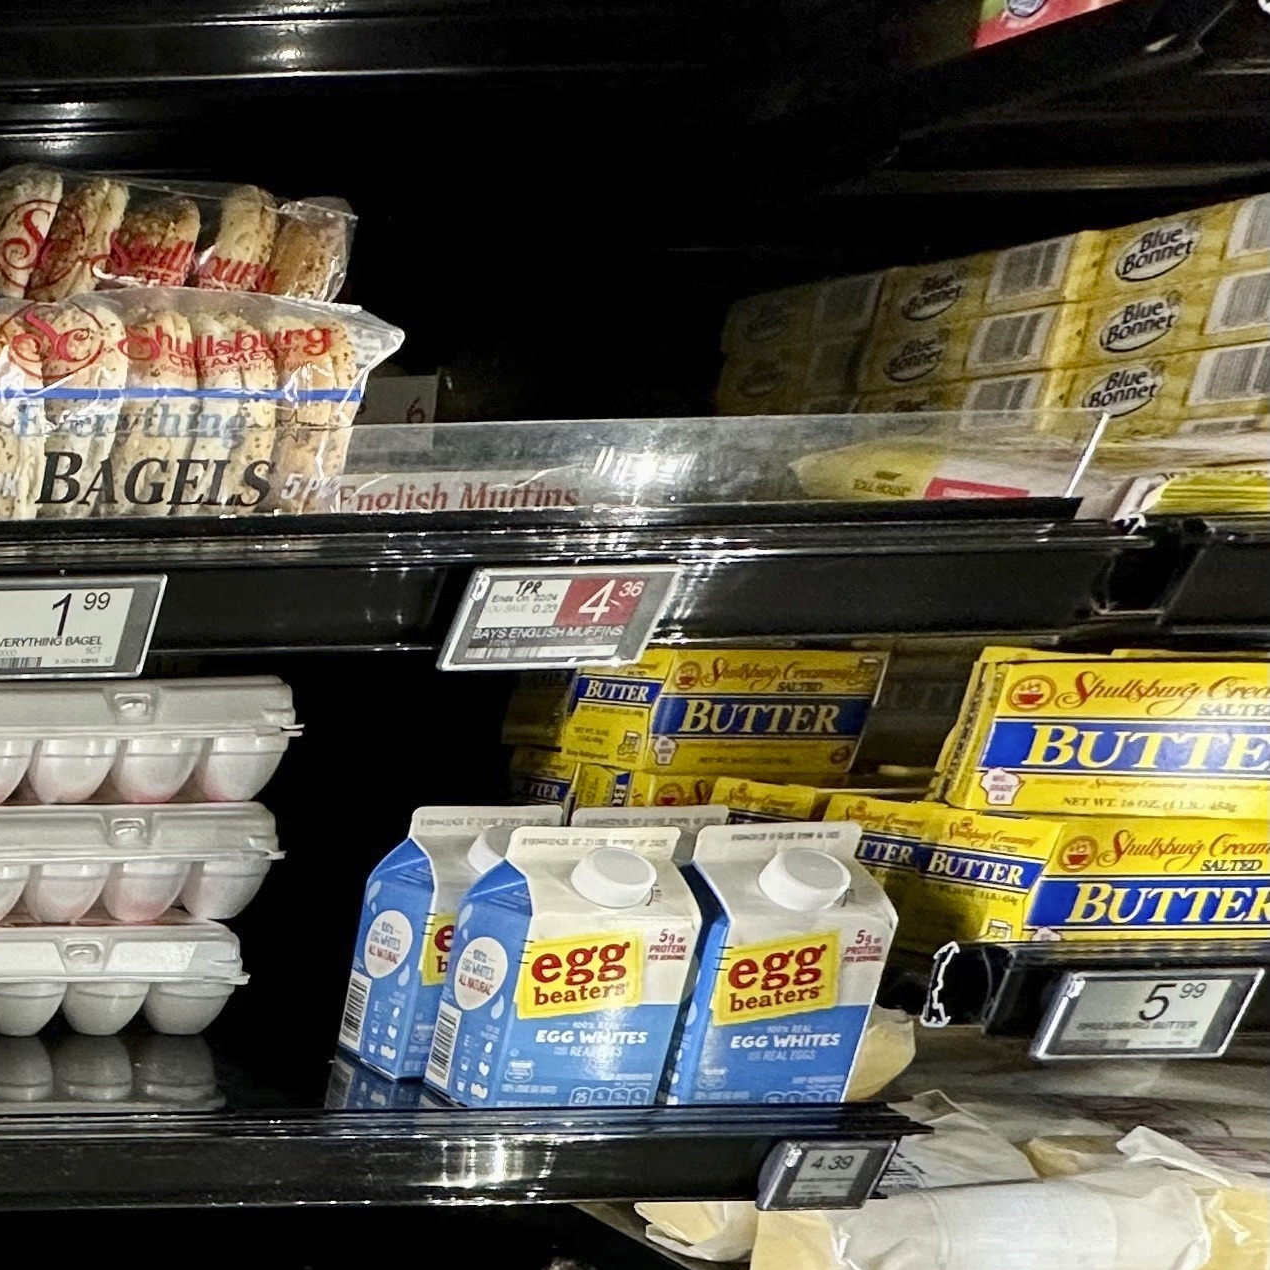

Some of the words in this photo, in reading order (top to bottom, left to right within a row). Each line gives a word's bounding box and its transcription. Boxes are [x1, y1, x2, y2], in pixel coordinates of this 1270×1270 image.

[1140, 223, 1182, 255] Blue
[1122, 234, 1195, 276] Bonnet
[1122, 299, 1163, 329] Blue
[118, 324, 332, 361] Shullsburg
[1105, 310, 1176, 349] Bonnet
[1107, 367, 1148, 391] Blue
[1088, 380, 1157, 410] Bonnet
[36, 451, 277, 508] BAGELS
[52, 592, 73, 637] 1
[579, 579, 616, 623] 4
[619, 580, 645, 597] 36
[64, 635, 102, 646] BAGEL
[472, 627, 508, 640] BAYS
[509, 626, 564, 638] ENGLISH
[566, 624, 624, 637] MUFFINS
[584, 680, 650, 703] BUTTER
[1055, 671, 1199, 717] Shullsburg
[679, 699, 841, 734] BUTTER
[1096, 829, 1206, 873] Shullsburg
[1200, 859, 1263, 872] SALTED
[927, 851, 1025, 886] BUTTER
[649, 944, 687, 954] PROTEIN
[658, 928, 676, 944] 5g
[855, 929, 872, 945] 5g
[531, 941, 631, 986] egg
[727, 943, 829, 991] egg
[534, 983, 626, 1006] beaters
[729, 986, 820, 1012] beaters
[1138, 982, 1178, 1022] 5
[1179, 982, 1208, 999] 99
[535, 1029, 575, 1044] EGG
[579, 1030, 649, 1045] WHITES
[730, 1035, 769, 1049] EGG
[773, 1033, 842, 1047] WHITES
[810, 1155, 855, 1171] 4.39
